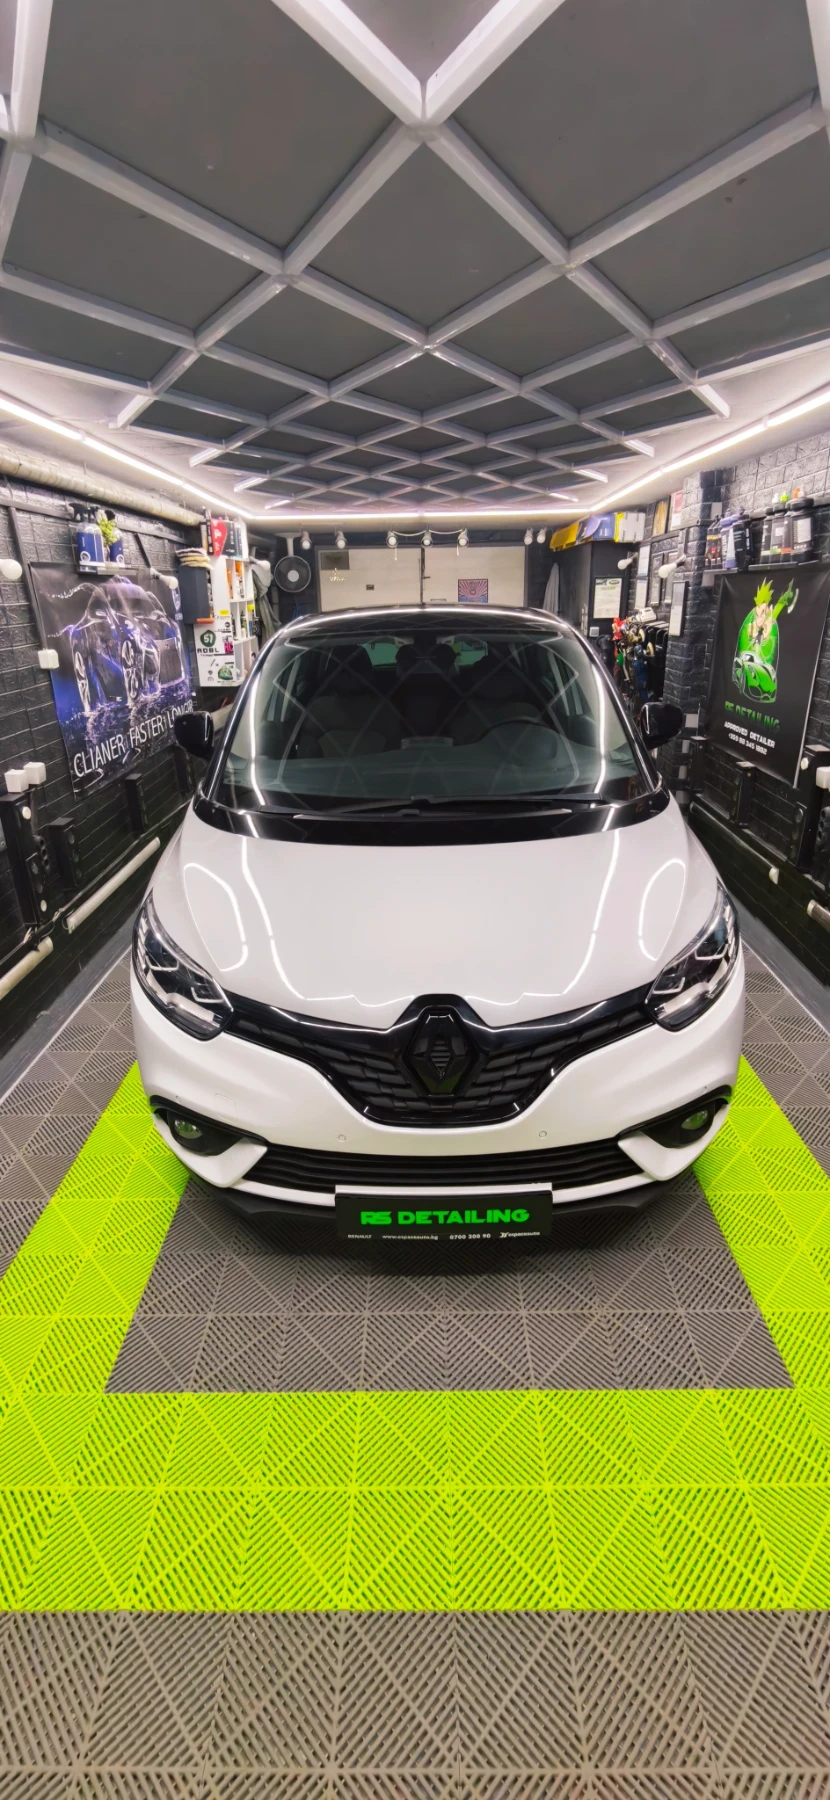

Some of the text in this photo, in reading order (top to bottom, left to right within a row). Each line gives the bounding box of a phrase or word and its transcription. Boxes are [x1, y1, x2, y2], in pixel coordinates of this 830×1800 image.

[129, 714, 165, 748] FASTER
[724, 721, 775, 748] APPROVED DETAILER
[360, 1208, 530, 1226] RS DETAILING
